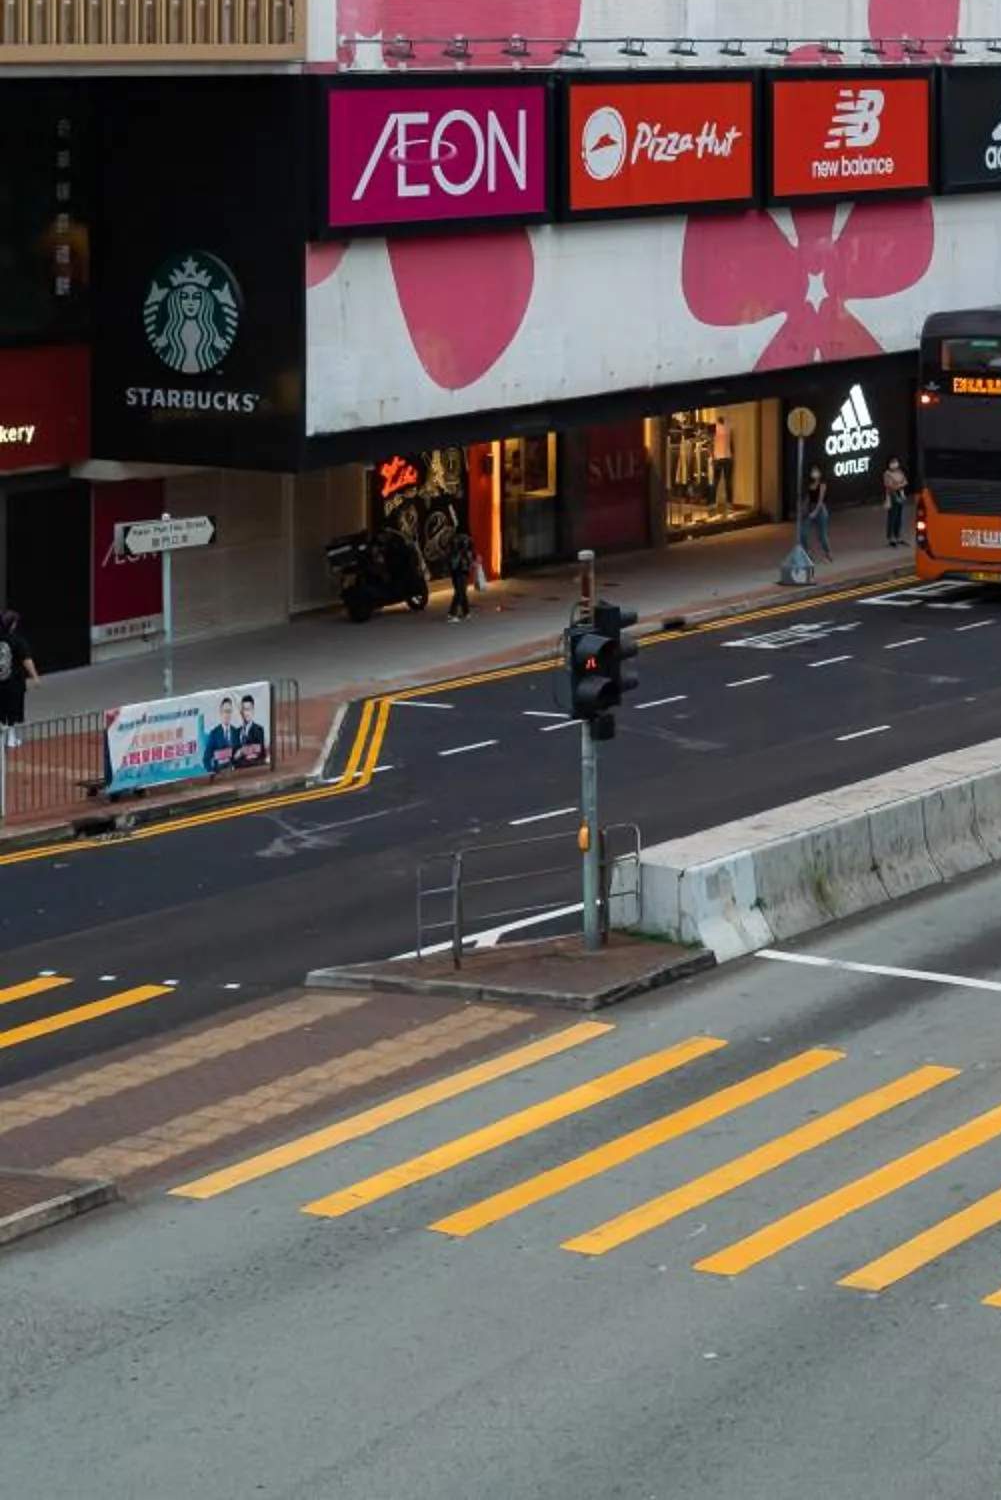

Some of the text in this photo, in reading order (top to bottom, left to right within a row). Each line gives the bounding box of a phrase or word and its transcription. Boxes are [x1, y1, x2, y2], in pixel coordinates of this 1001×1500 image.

[631, 120, 742, 165] Pizza Hut
[812, 155, 895, 179] new balance
[125, 386, 256, 412] STARBUCKS
[825, 426, 880, 456] adidas
[589, 451, 641, 483] SALE
[833, 456, 870, 477] OUTLET
